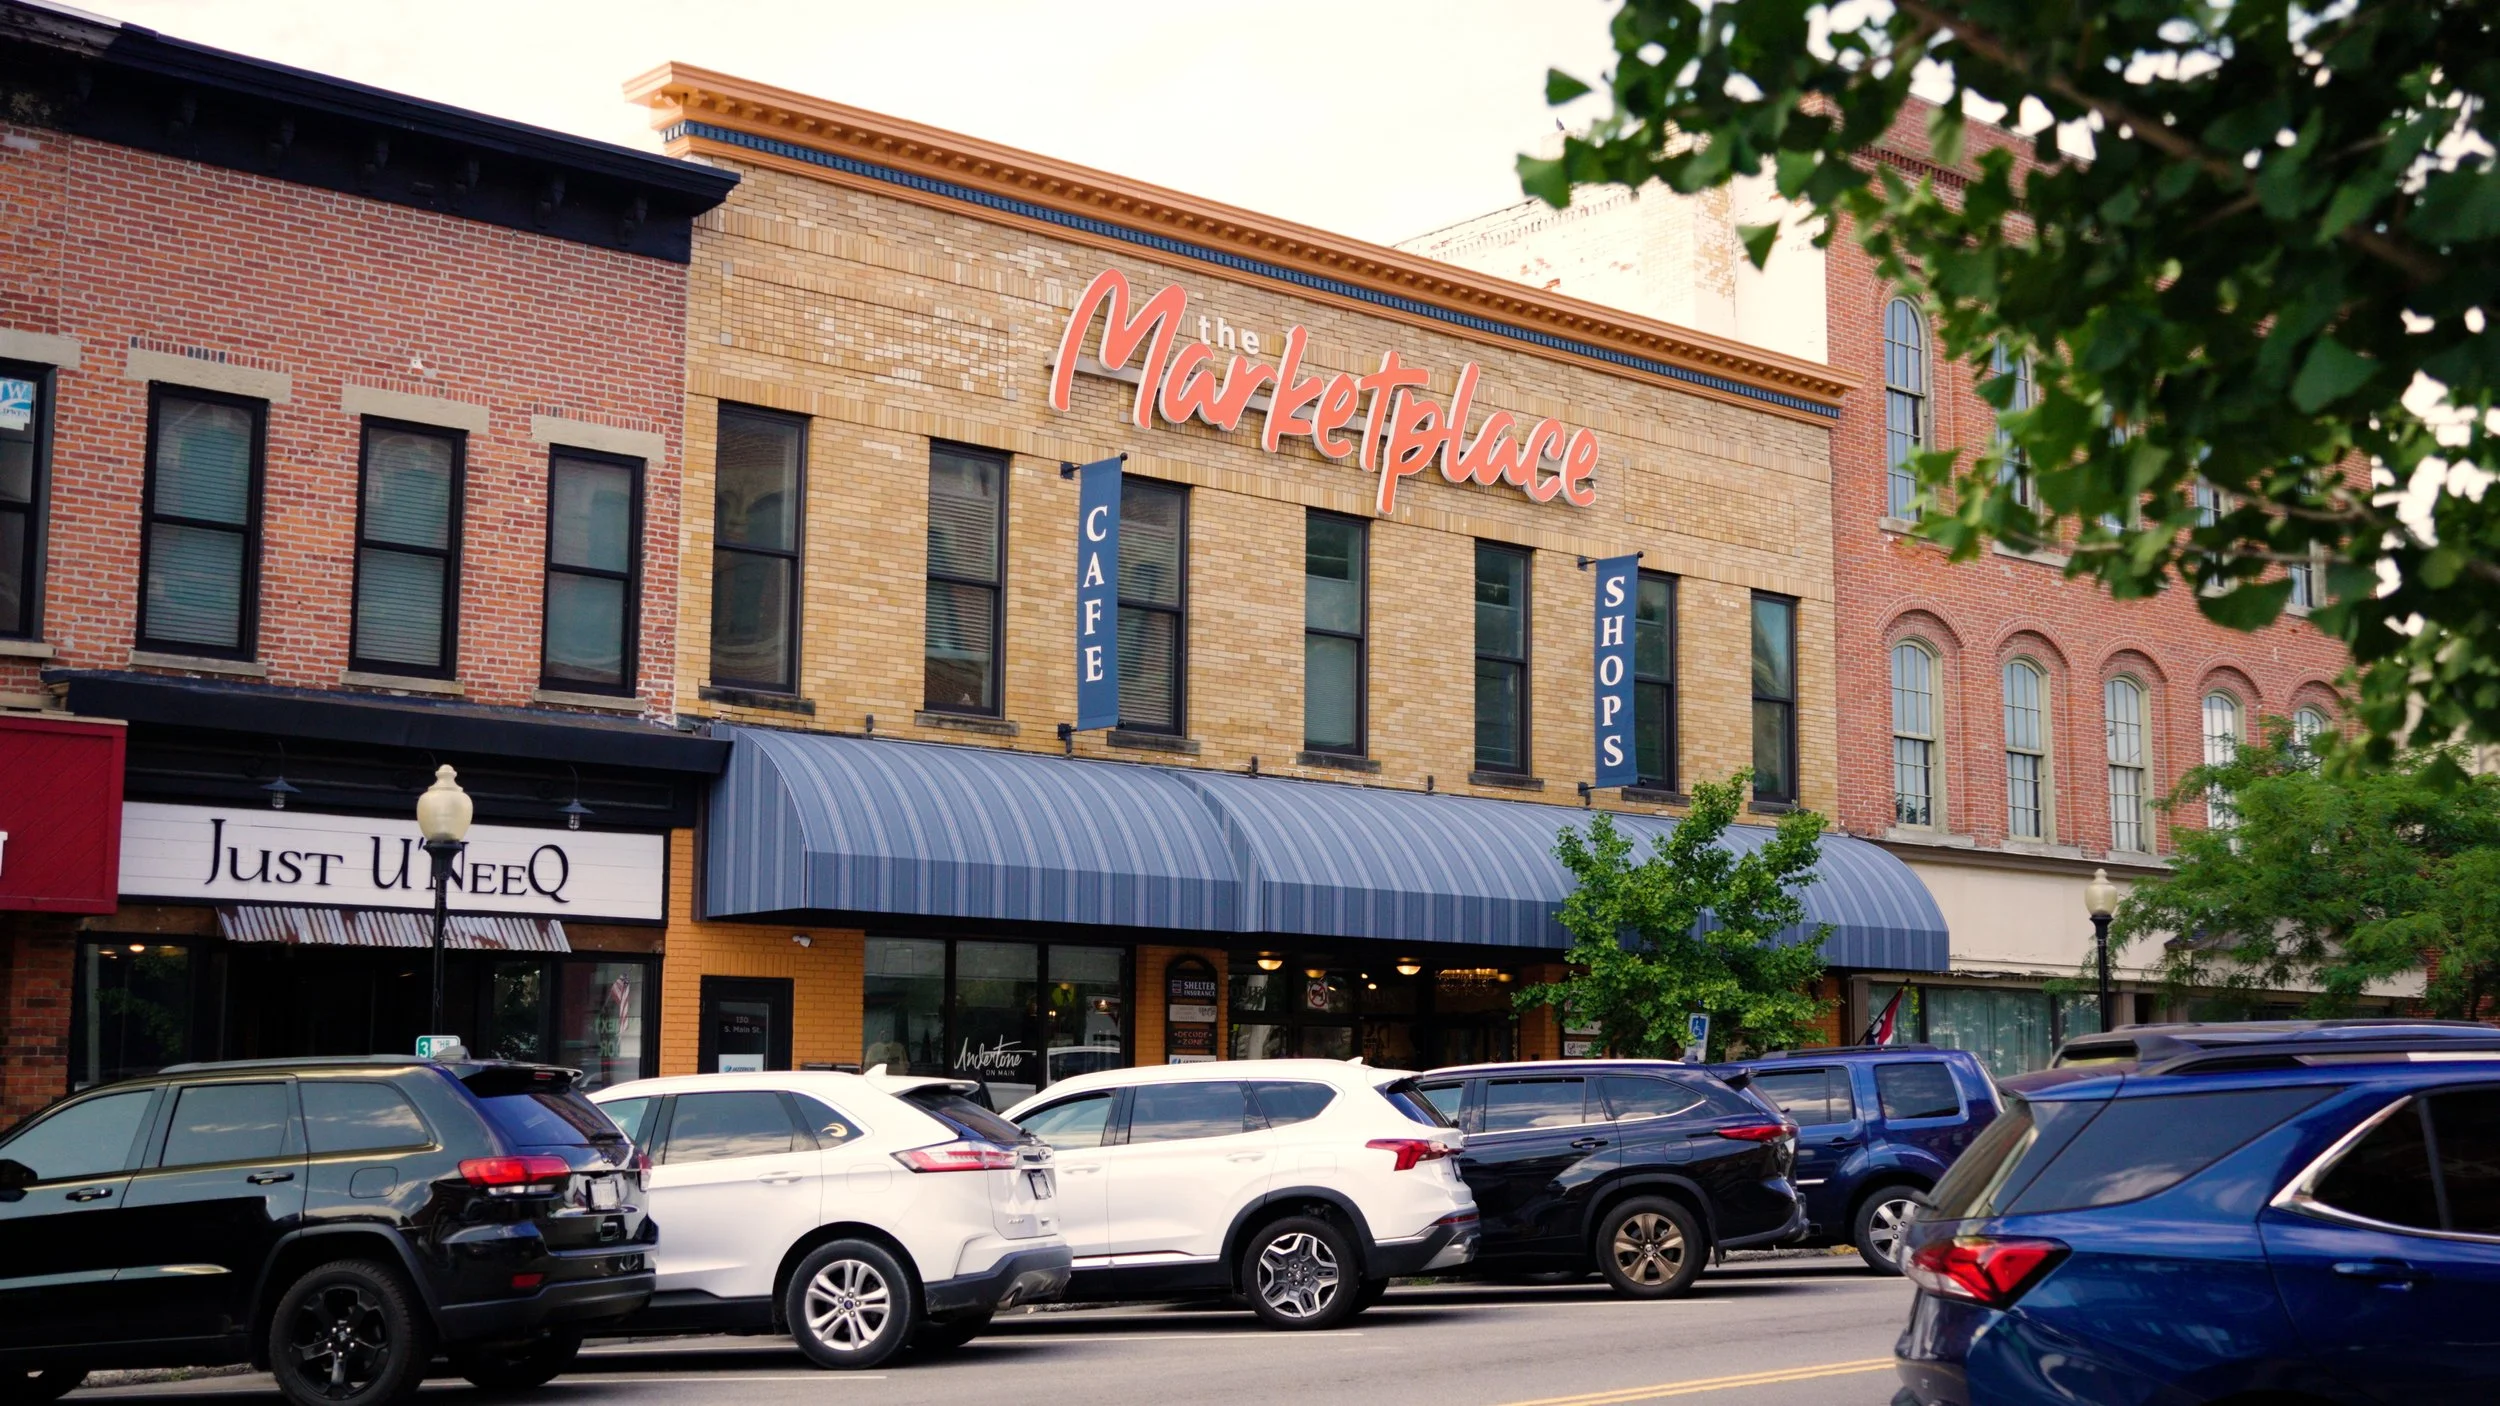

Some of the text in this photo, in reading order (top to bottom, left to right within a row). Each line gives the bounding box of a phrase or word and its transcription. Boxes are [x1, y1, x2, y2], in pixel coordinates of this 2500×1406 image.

[1197, 314, 1260, 354] the
[1048, 267, 1601, 515] Marketplace
[1084, 504, 1109, 684] CAFE
[1601, 574, 1625, 768] SHOPS
[1183, 981, 1216, 990] SHELTER
[419, 1041, 430, 1058] 3
[1177, 1031, 1208, 1039] DECODE
